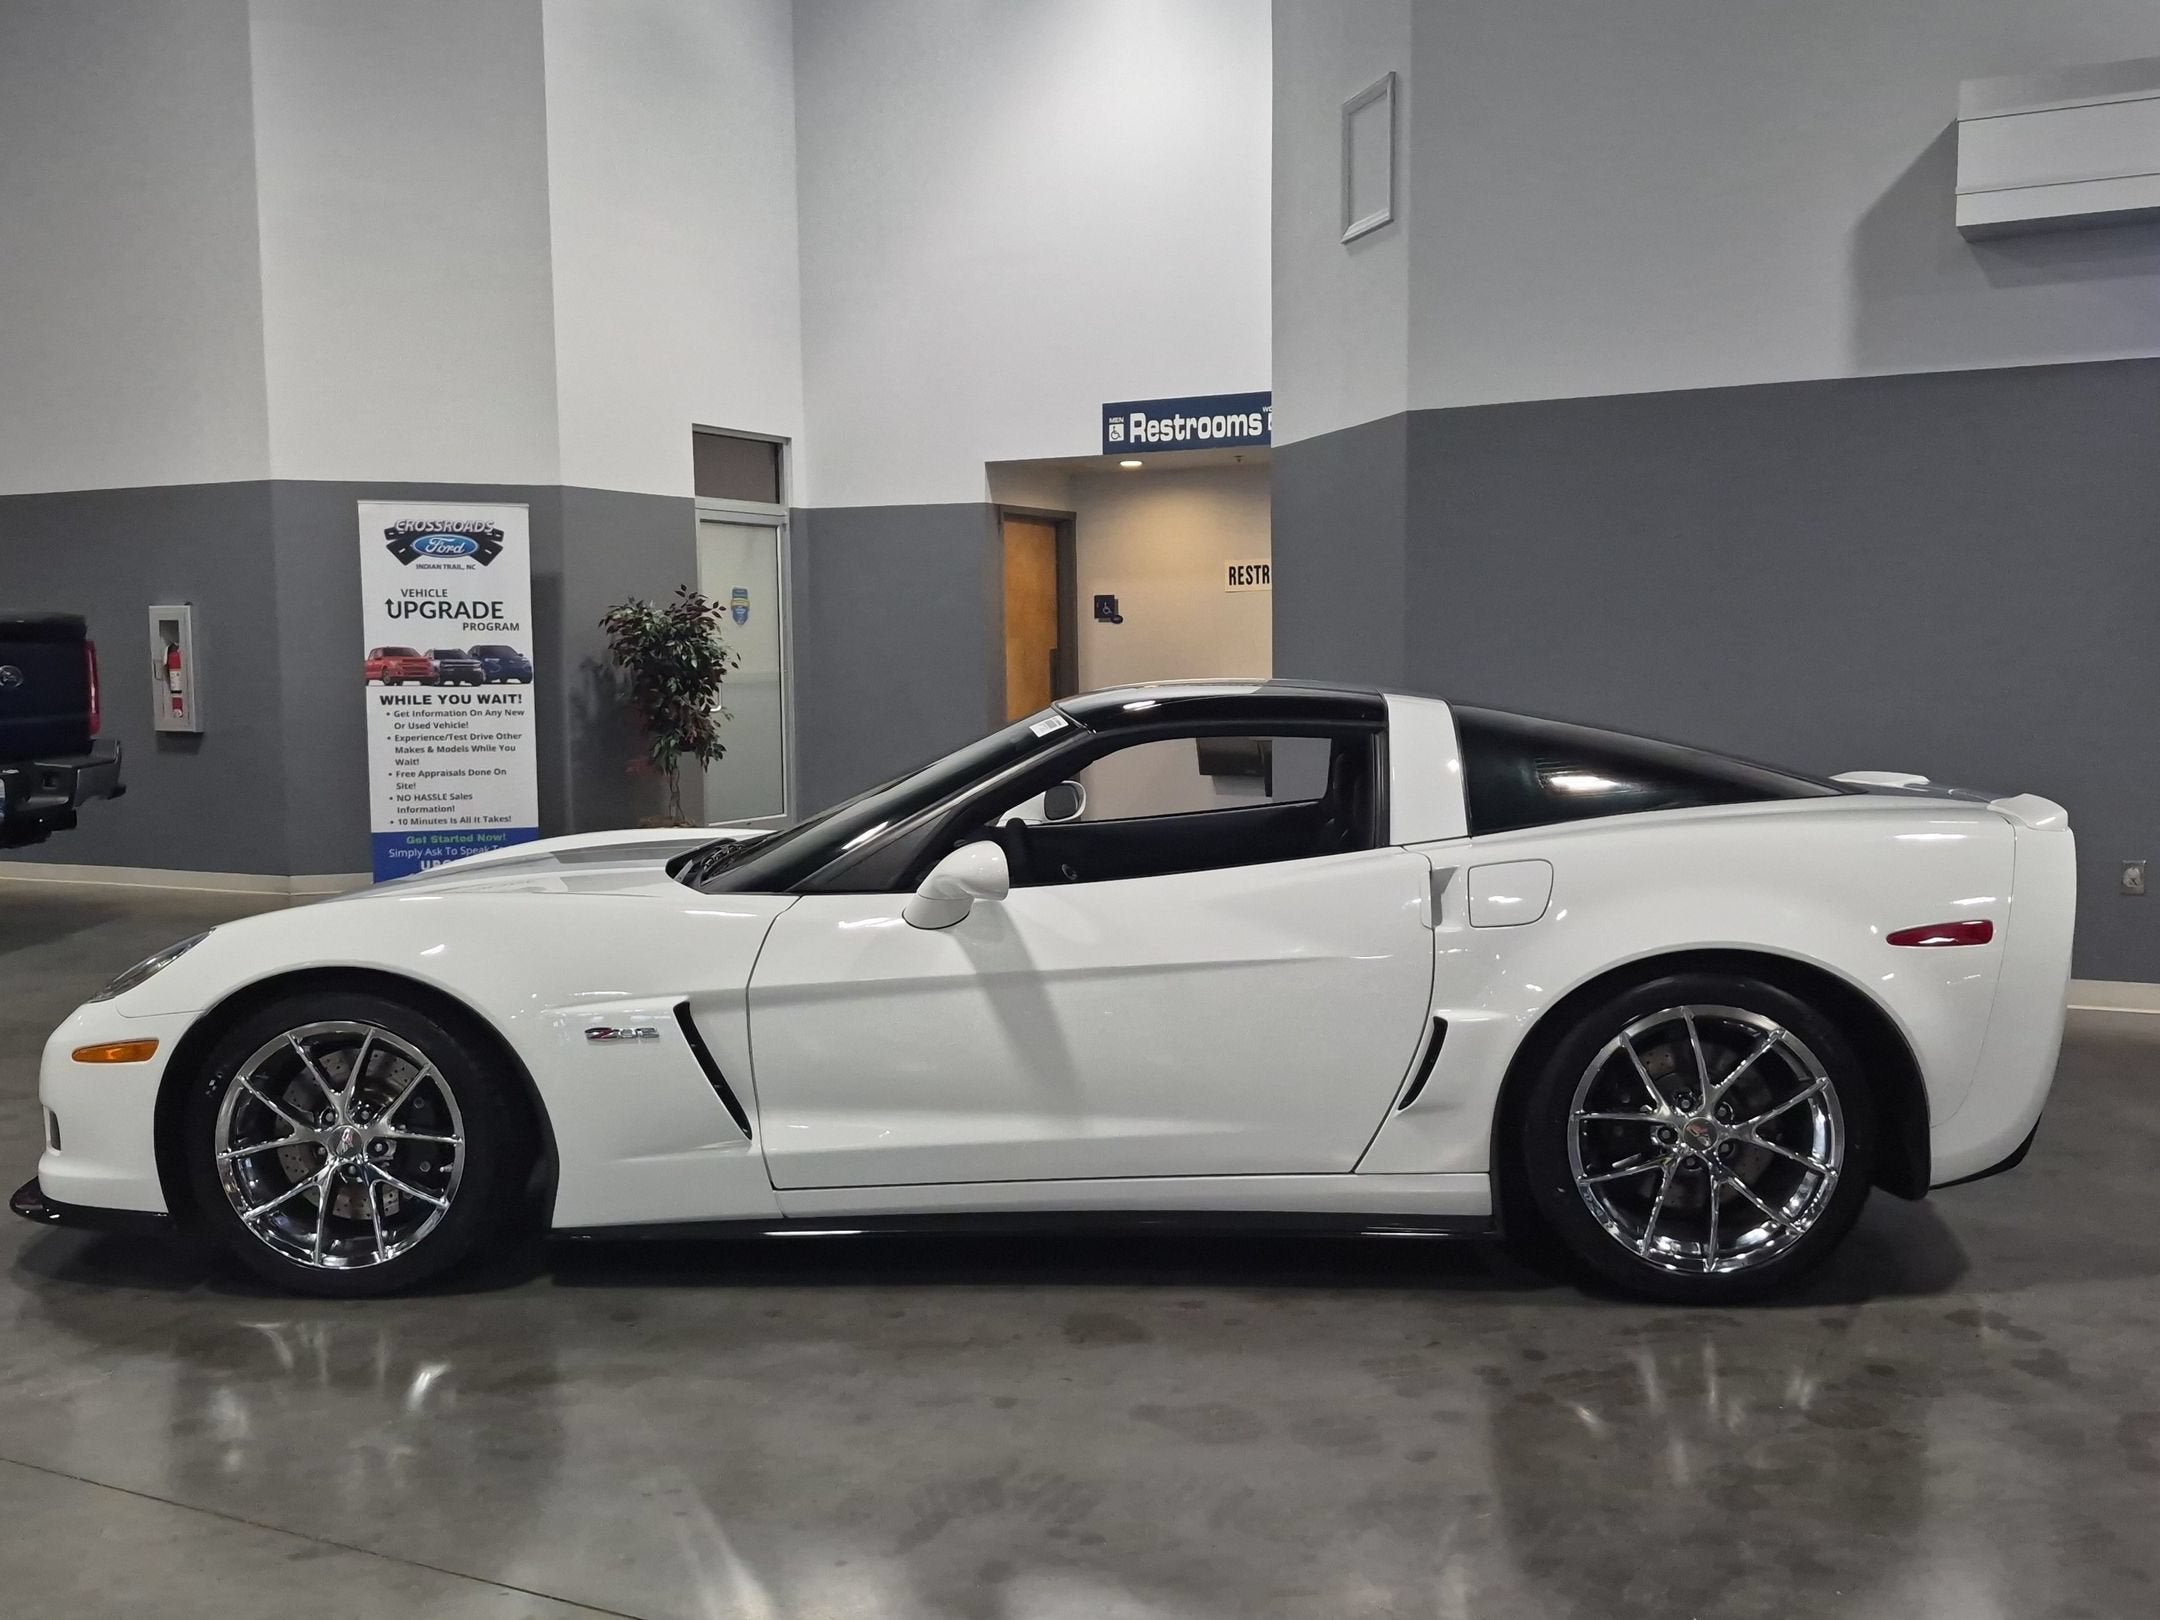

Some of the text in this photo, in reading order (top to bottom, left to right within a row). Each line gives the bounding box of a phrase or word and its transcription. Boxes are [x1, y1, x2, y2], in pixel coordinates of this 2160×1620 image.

[1129, 412, 1263, 444] Restrooms
[395, 519, 495, 534] CROSSROADS
[425, 537, 466, 554] Ford
[1228, 564, 1271, 586] RESTR
[401, 588, 448, 598] VEHICLE
[385, 599, 504, 620] UPGRADE
[462, 622, 520, 631] PROGRAM
[380, 693, 522, 706] WHILE YOU WAIT!
[394, 709, 525, 718] Get Information On Any New
[394, 721, 469, 730] Or Used Vehicle!
[394, 733, 468, 743] Experience/Test
[496, 732, 522, 740] Other
[395, 746, 425, 754] Makes
[427, 745, 435, 753] &
[436, 745, 470, 753] Models
[471, 744, 496, 752] While
[395, 758, 420, 766] Wait!
[396, 768, 507, 779] Free Appraisals Done On
[396, 782, 416, 790] Site!
[396, 792, 473, 802] NO HASSLE Sales
[397, 805, 455, 814] Information!
[398, 818, 408, 826] 10
[410, 817, 448, 825] Minutes
[460, 816, 472, 824] All
[482, 815, 512, 823] Takes!
[406, 832, 506, 845] Get Started Now!
[388, 848, 424, 859] Simply
[425, 847, 443, 857] Ask
[445, 846, 458, 856] To
